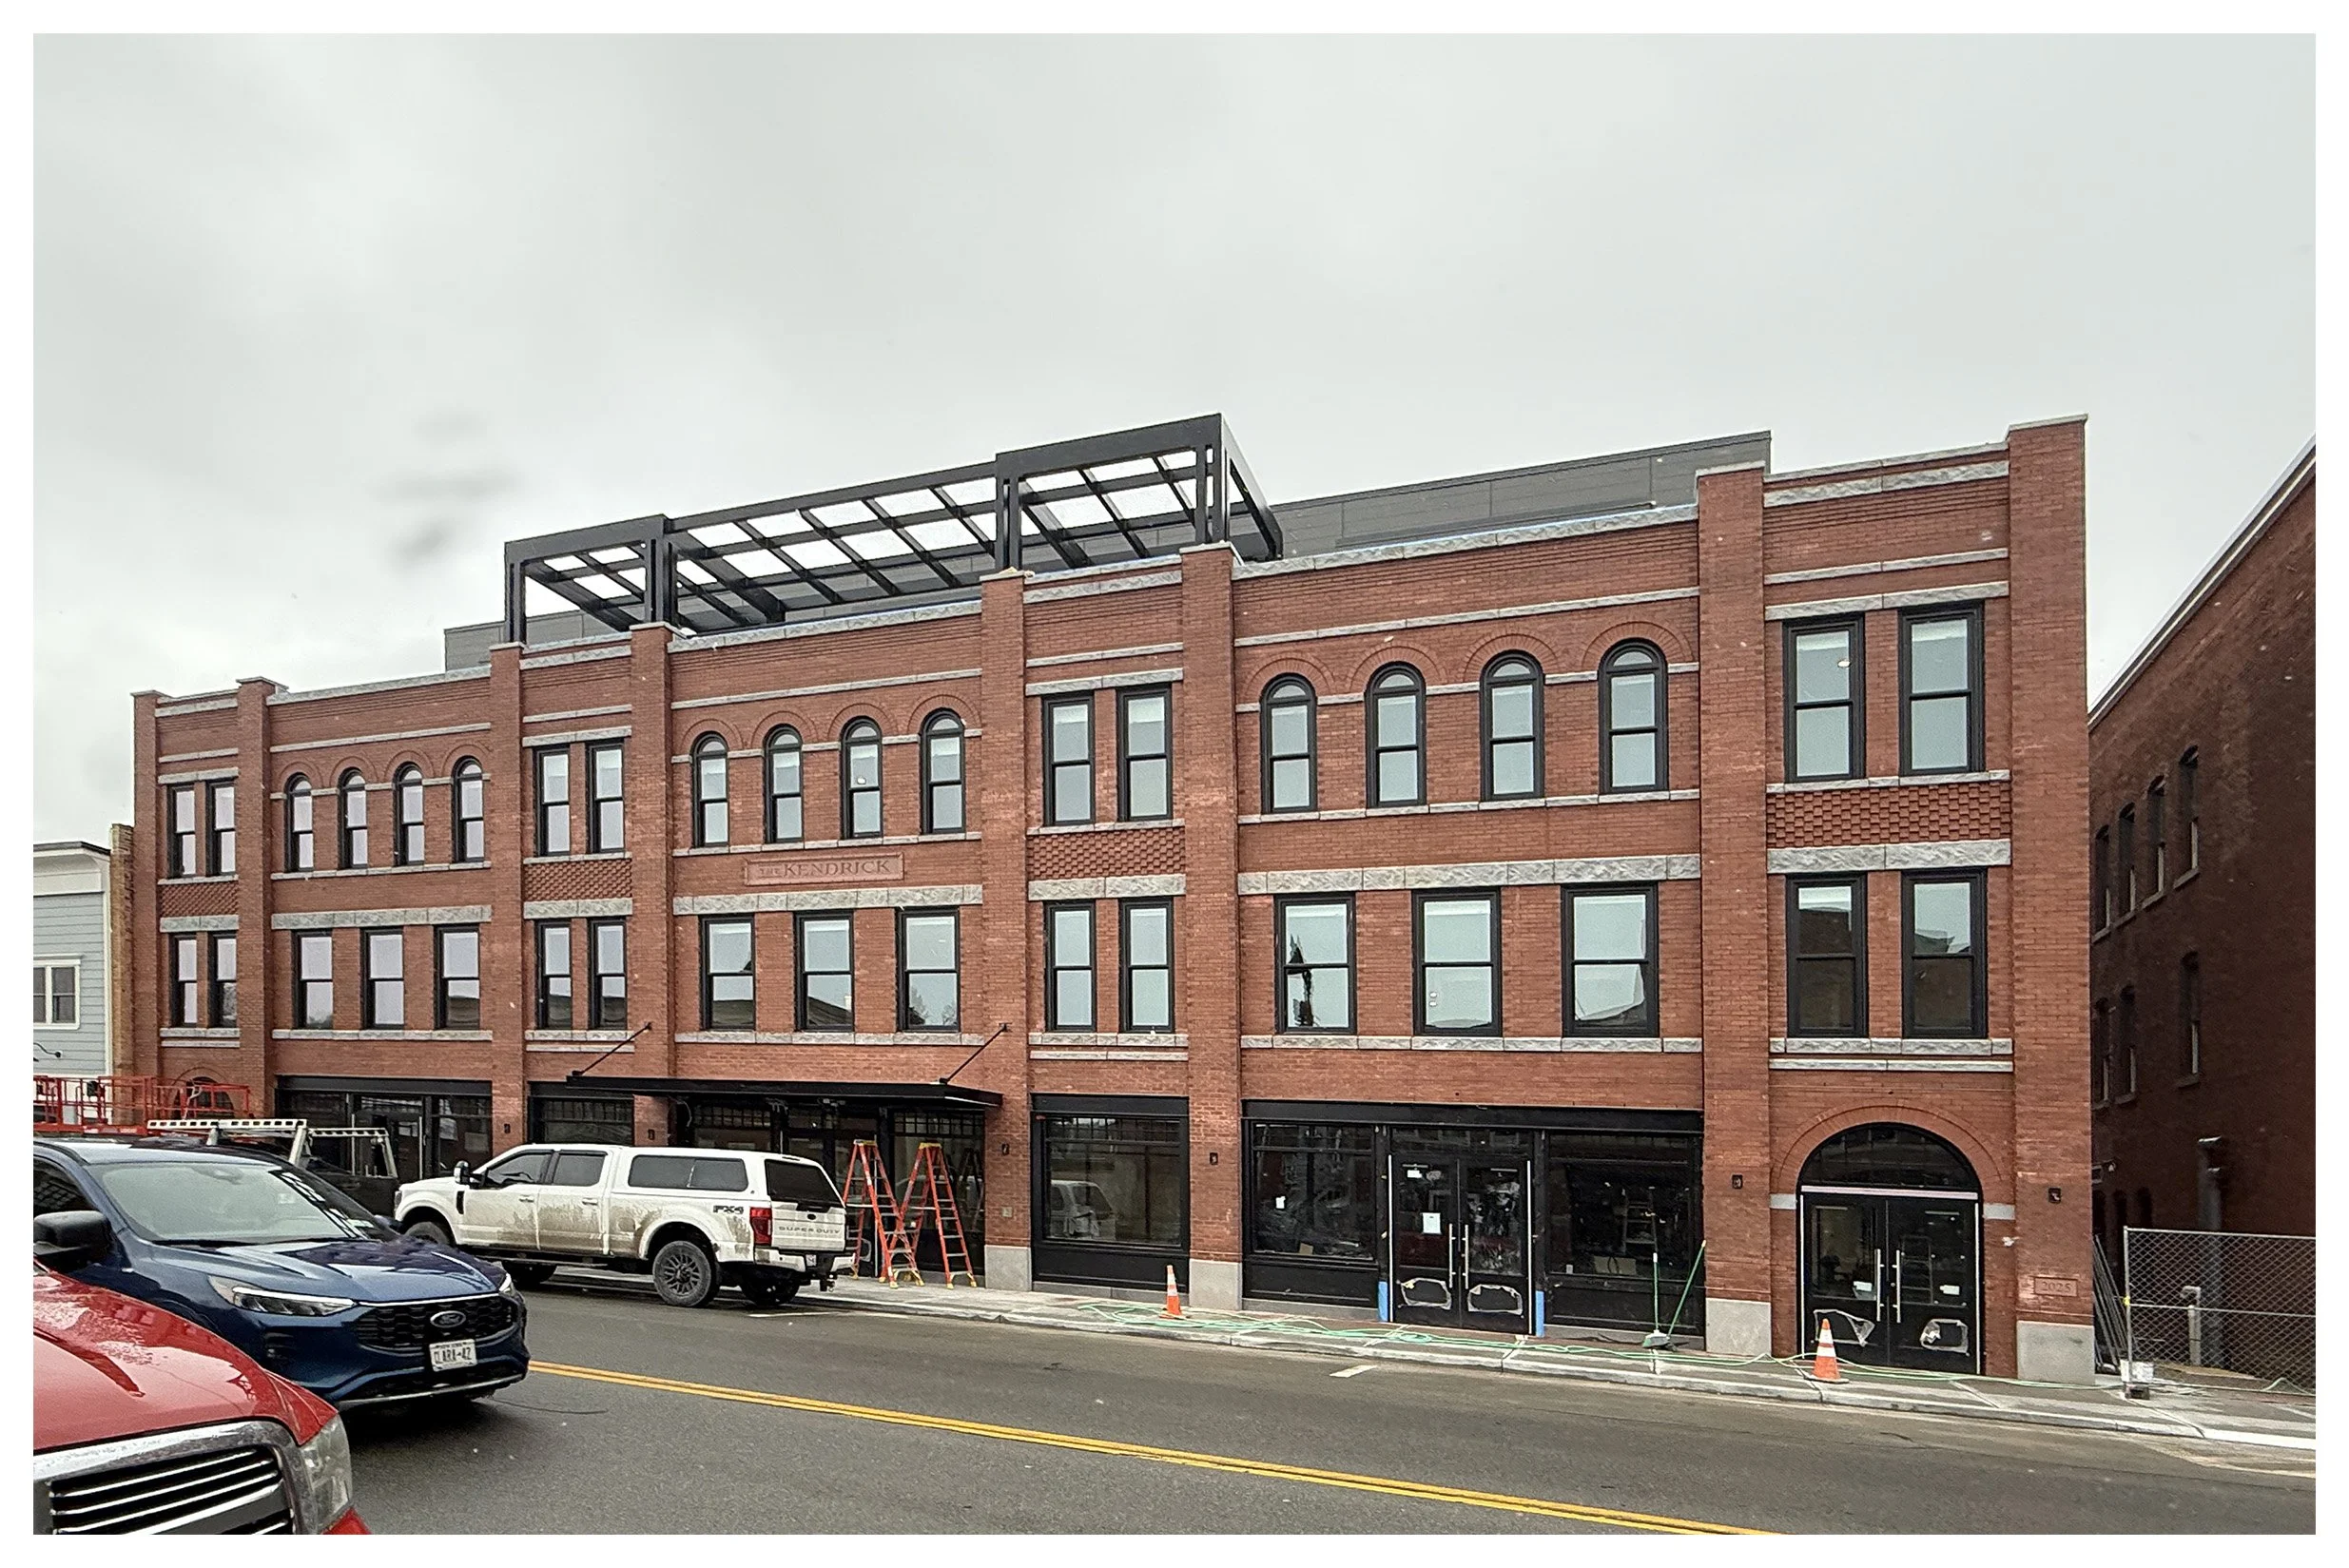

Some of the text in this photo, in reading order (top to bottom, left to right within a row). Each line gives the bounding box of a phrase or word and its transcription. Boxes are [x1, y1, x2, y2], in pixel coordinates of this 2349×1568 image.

[783, 860, 890, 877] KENDRICK
[713, 1205, 744, 1214] FX4
[2041, 1281, 2072, 1292] 2025
